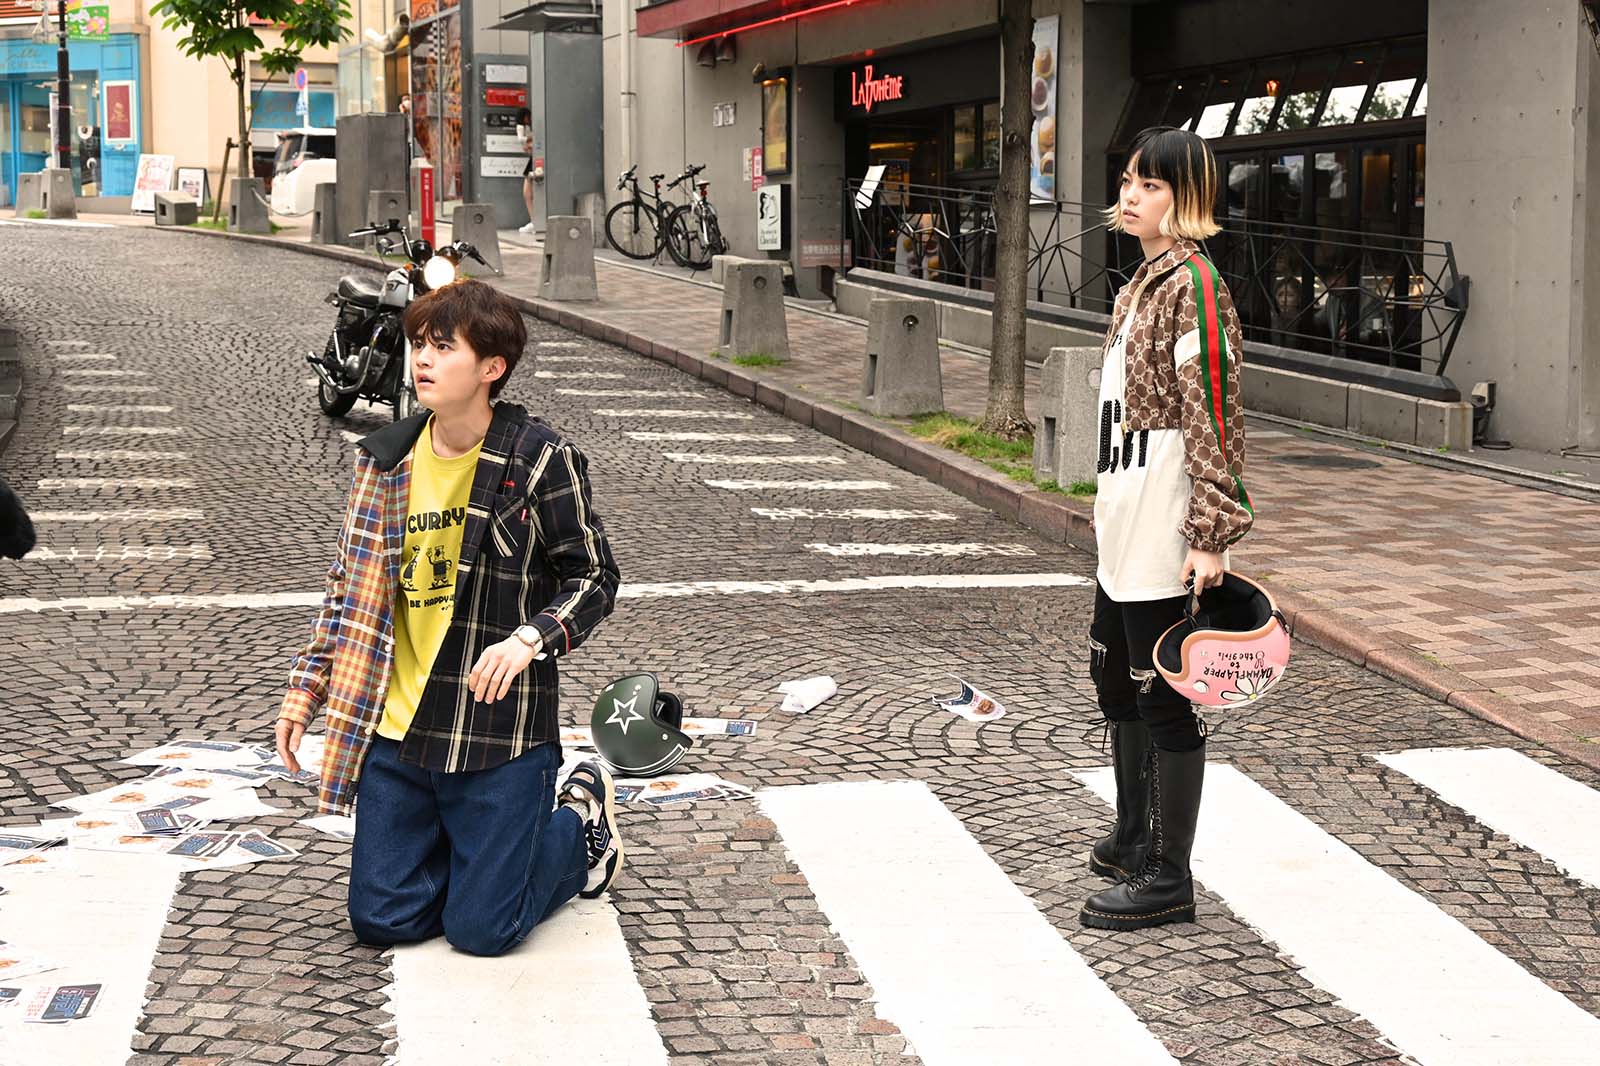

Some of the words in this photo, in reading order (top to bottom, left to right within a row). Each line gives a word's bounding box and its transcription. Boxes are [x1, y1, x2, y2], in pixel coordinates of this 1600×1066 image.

[407, 507, 465, 534] CURRY
[409, 599, 421, 608] BE
[424, 595, 449, 607] HAPPY
[1230, 661, 1241, 669] to
